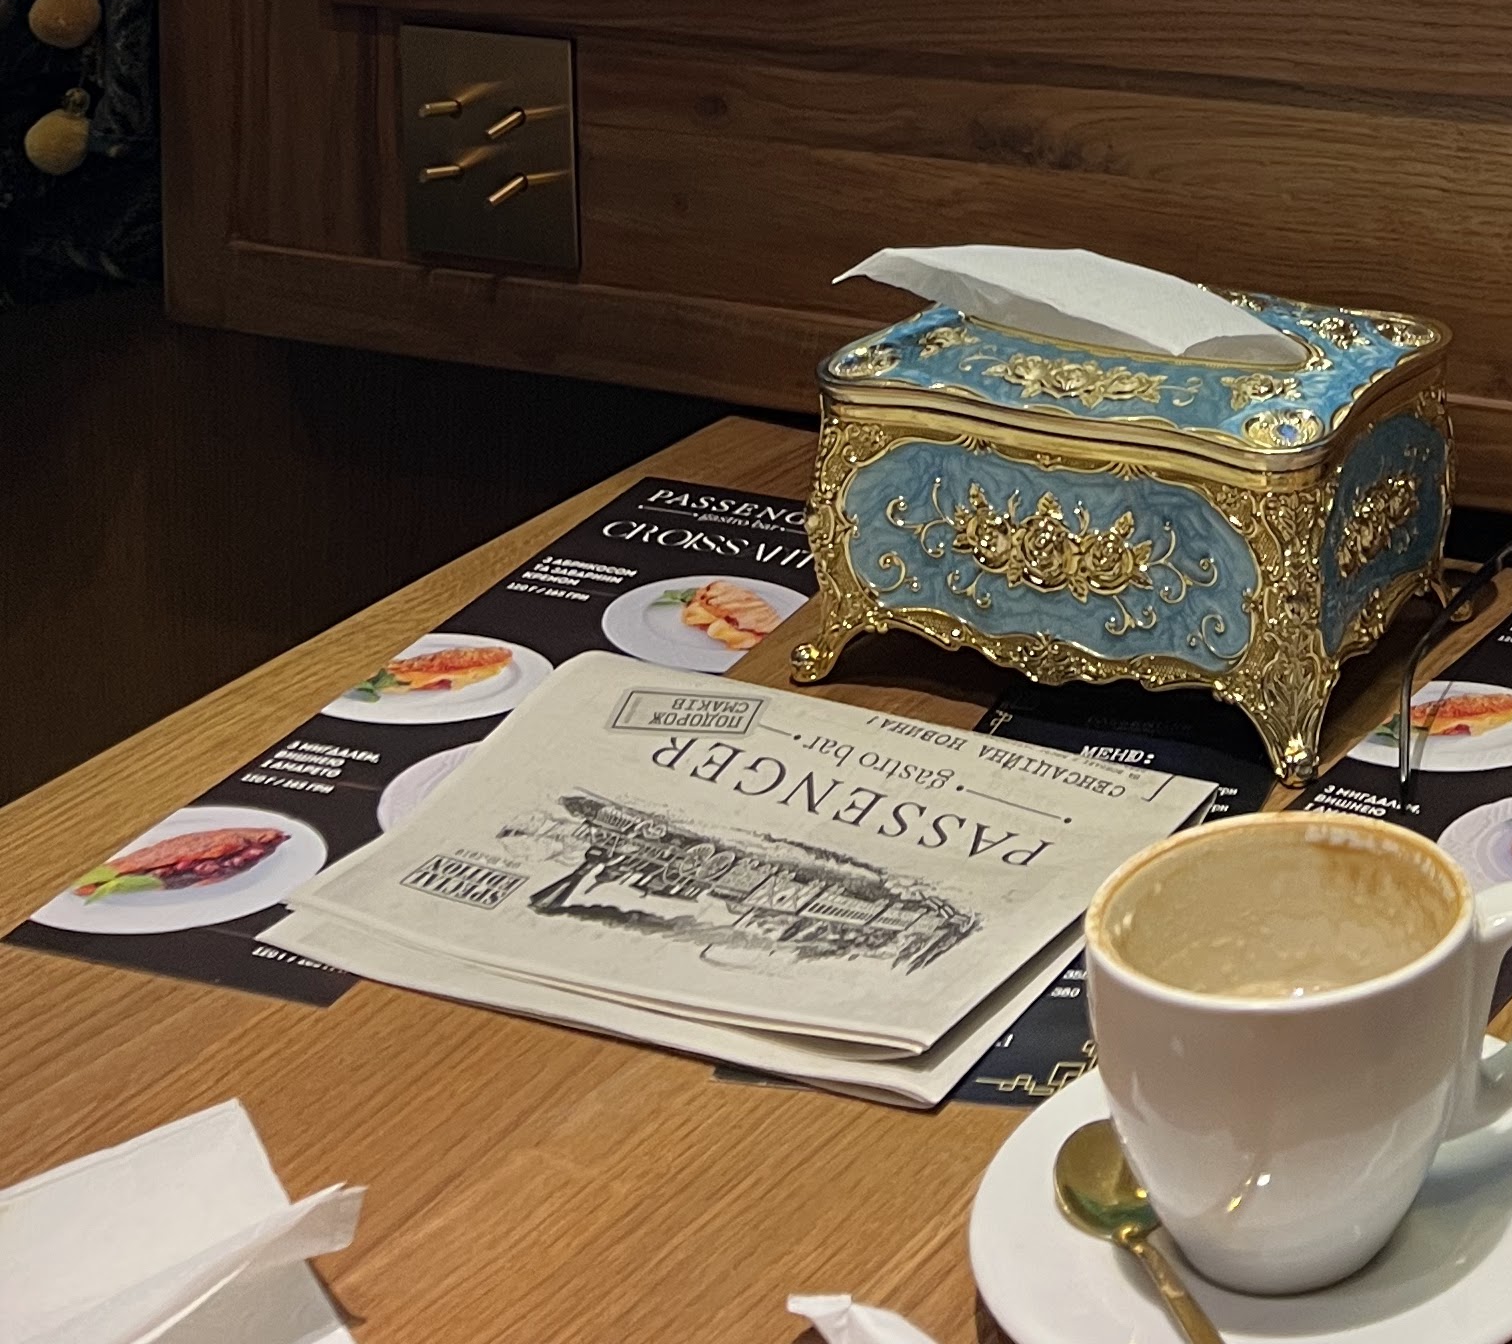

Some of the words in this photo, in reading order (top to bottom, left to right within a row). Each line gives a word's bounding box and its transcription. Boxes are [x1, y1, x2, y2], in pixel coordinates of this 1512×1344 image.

[647, 489, 806, 525] PASSENG
[521, 571, 580, 586] КРЕМОМ
[648, 712, 744, 729] ПОДОРОЖ
[672, 698, 749, 714] СМАКІВ
[803, 733, 855, 767] bar
[859, 752, 956, 791] gastro
[978, 744, 1126, 798] СЕНСАЦІЙНА
[650, 736, 1055, 867] PASSENGER
[1314, 794, 1386, 816] ВИШНЕЮ
[1336, 788, 1420, 815] МИГДАЛМ,
[411, 871, 499, 904] SPECIAL
[431, 859, 521, 890] EDITION
